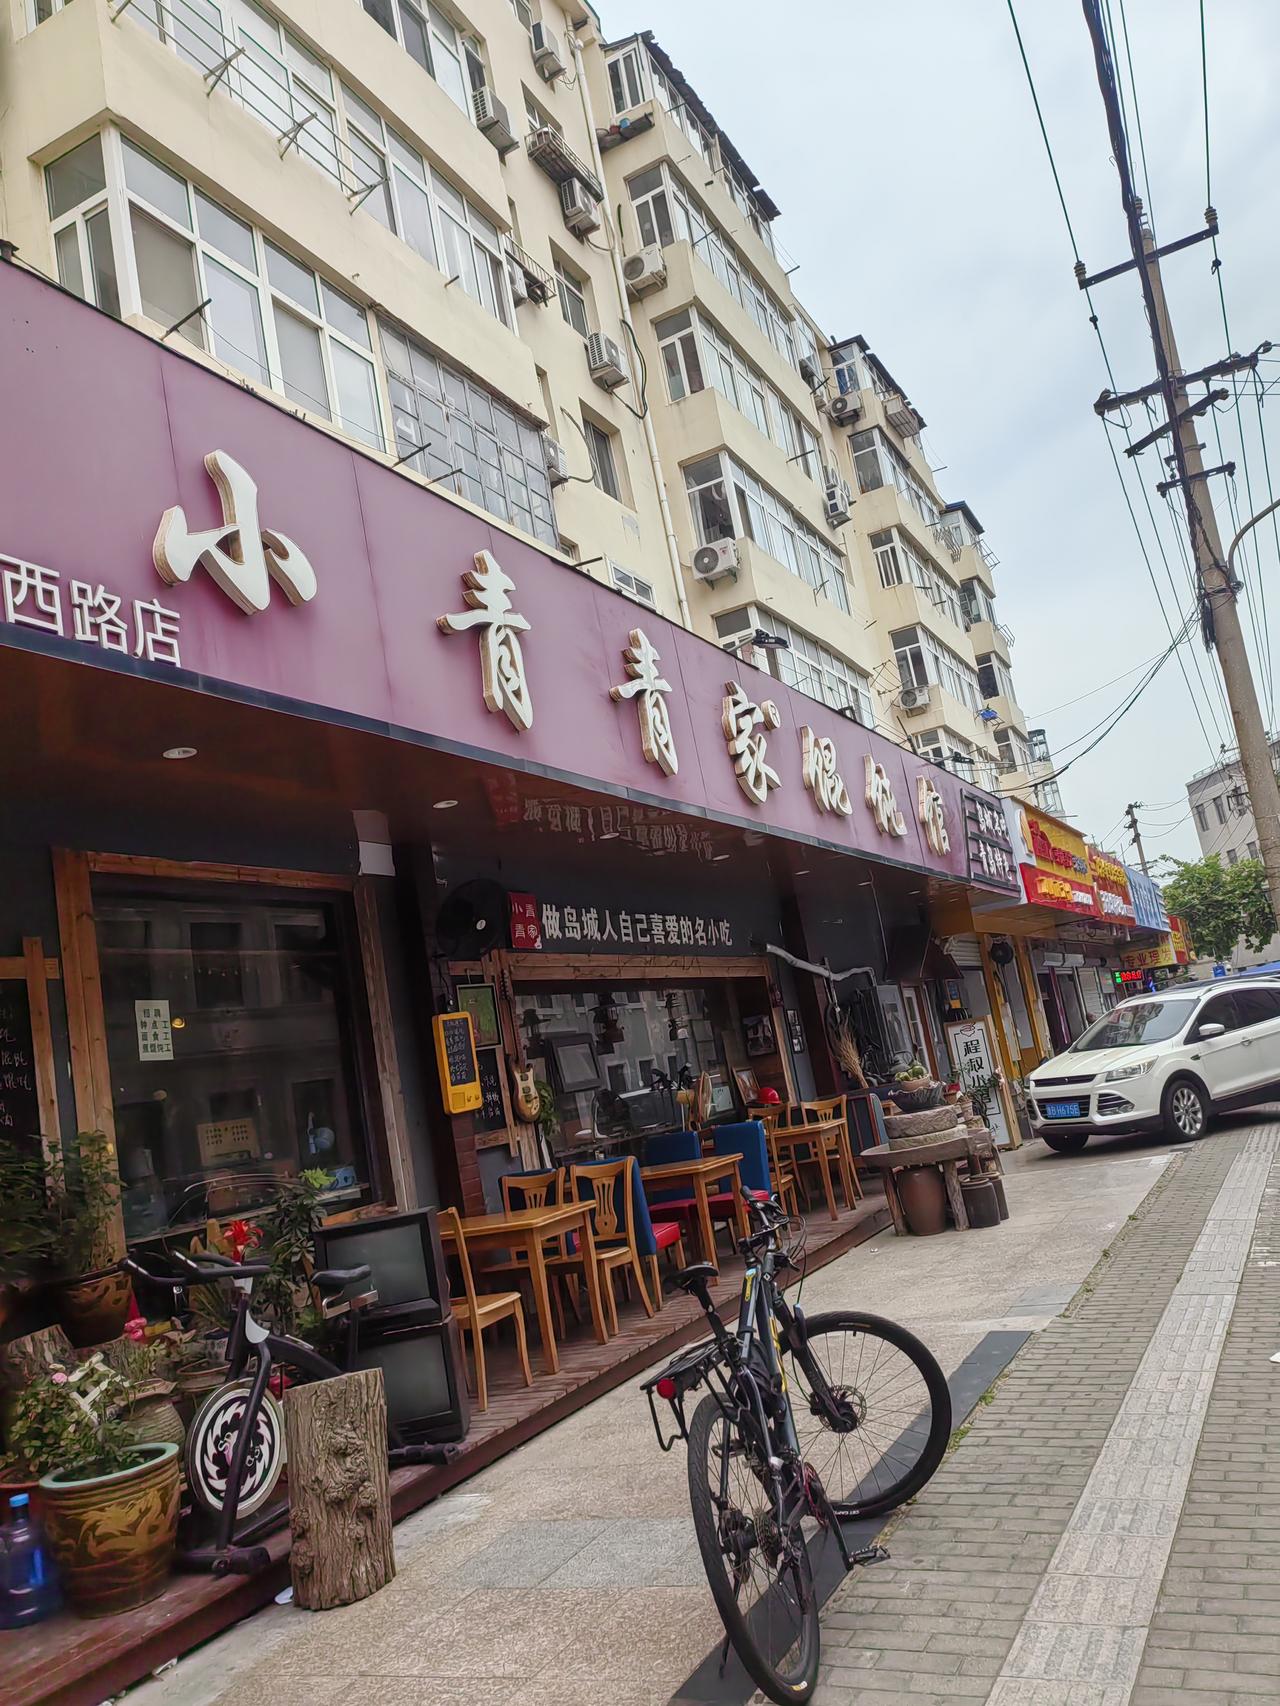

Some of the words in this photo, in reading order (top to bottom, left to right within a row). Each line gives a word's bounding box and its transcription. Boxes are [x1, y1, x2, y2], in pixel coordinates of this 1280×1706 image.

[0, 553, 181, 667] 西路店
[511, 902, 536, 918] 小青
[541, 903, 733, 946] 做岛城人自己喜爱的名小吃
